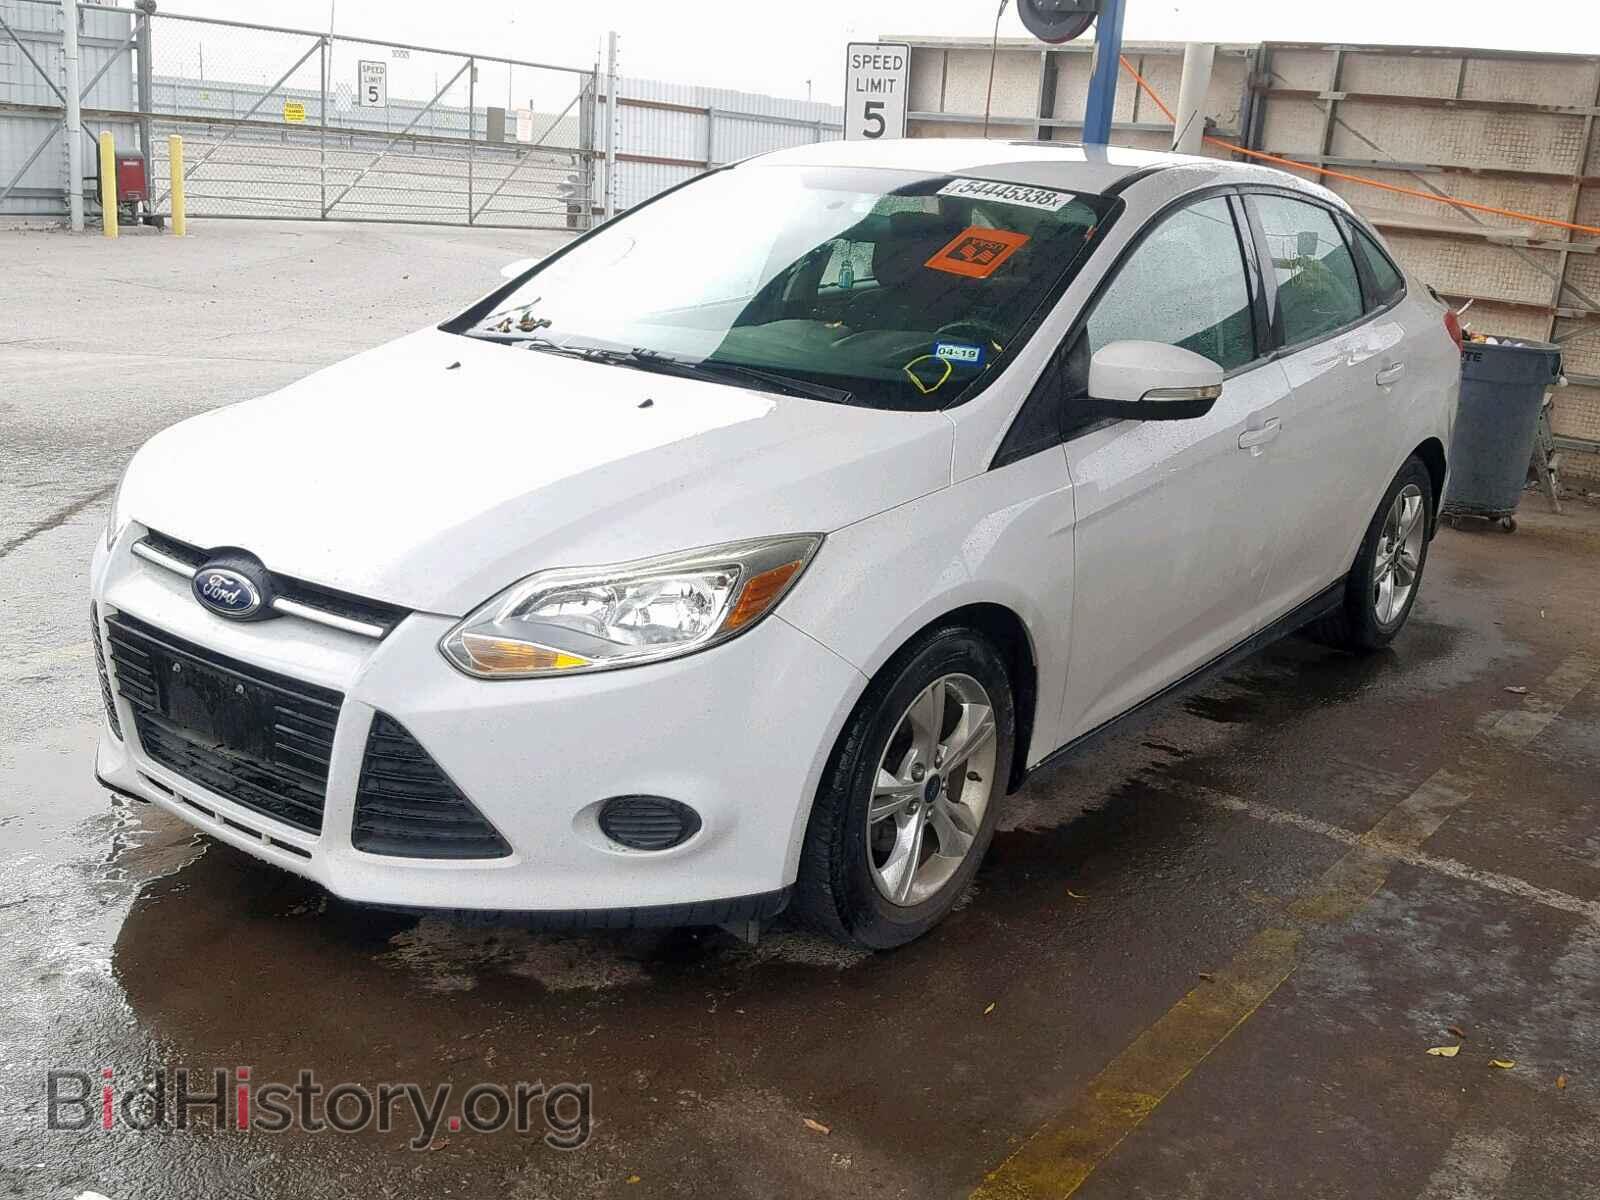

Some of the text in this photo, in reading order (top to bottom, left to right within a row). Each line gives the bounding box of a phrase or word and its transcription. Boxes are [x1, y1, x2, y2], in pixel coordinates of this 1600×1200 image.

[362, 64, 385, 74] SPEED
[852, 54, 903, 70] SPEED
[364, 75, 383, 84] LIMIT
[856, 77, 897, 93] LIMIT
[368, 86, 379, 103] 5
[862, 101, 886, 139] 5
[203, 574, 242, 605] Ford
